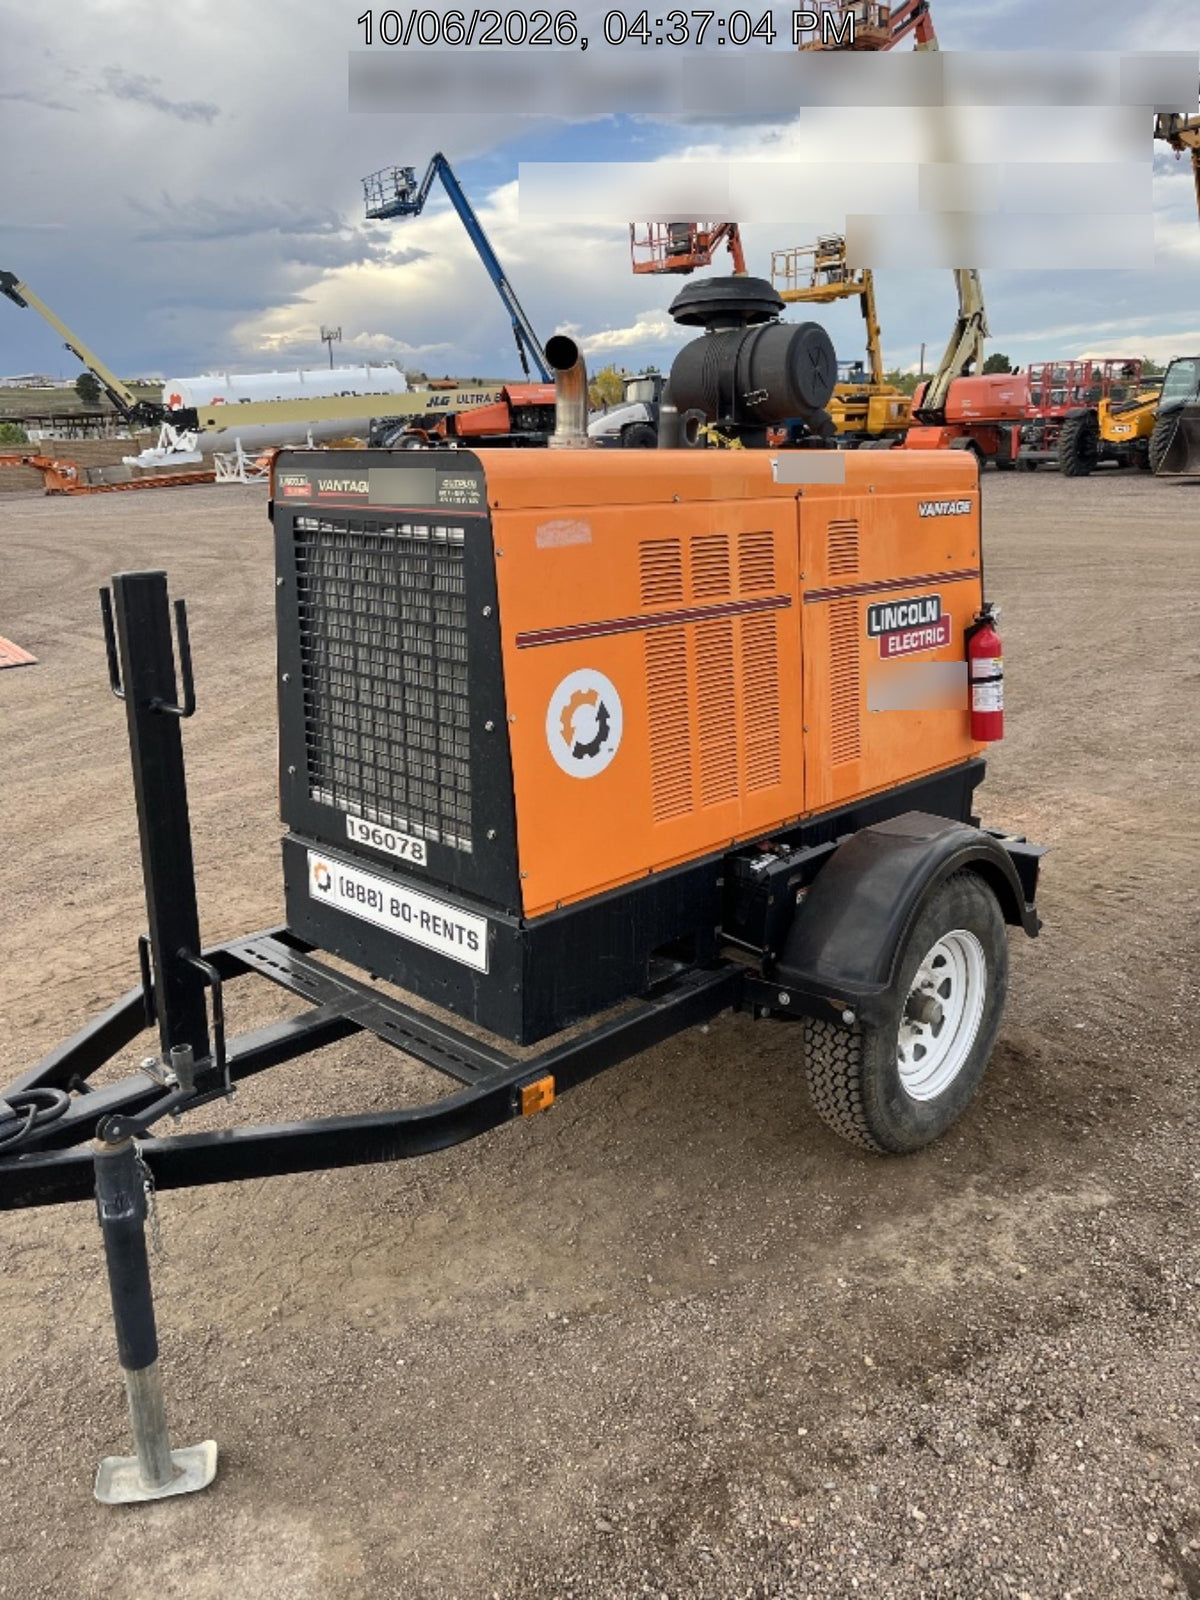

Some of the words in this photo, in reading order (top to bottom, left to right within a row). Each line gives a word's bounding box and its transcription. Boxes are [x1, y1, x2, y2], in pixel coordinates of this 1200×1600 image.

[426, 395, 451, 408] JLG
[456, 393, 491, 405] ULTRA
[918, 500, 971, 516] VANTAGE
[871, 600, 938, 632] LINCOLN
[888, 627, 945, 653] ELECTRIC
[348, 820, 424, 861] 196078
[339, 876, 383, 912] (888)
